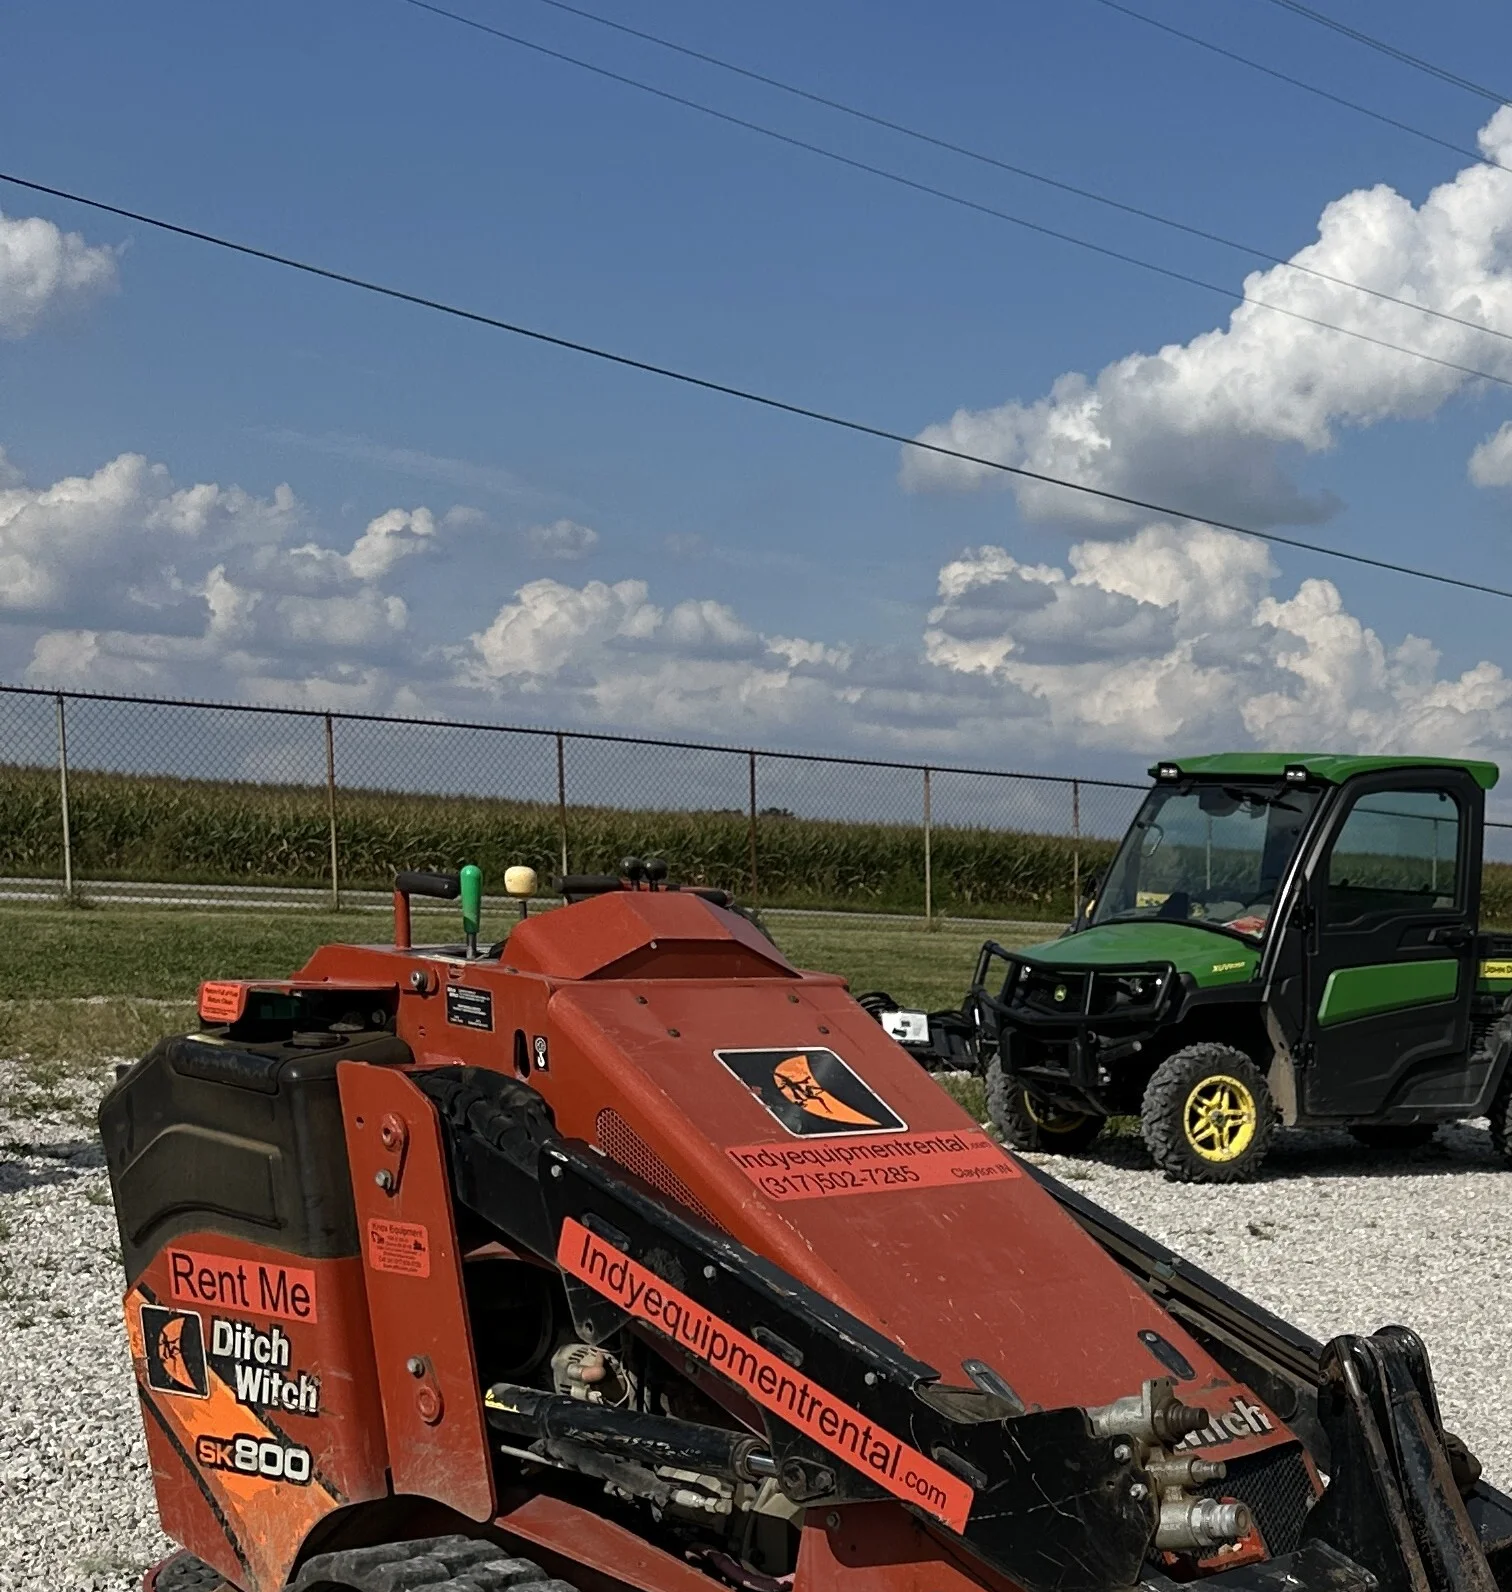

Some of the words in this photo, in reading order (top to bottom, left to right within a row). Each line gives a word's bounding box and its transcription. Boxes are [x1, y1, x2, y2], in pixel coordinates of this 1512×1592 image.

[1485, 965, 1506, 974] JOHN
[758, 1165, 920, 1198] (317)502-7285
[950, 1166, 998, 1179] Clayton
[171, 1252, 250, 1307] Rent
[258, 1266, 311, 1317] Me
[212, 1320, 289, 1366] Ditch
[235, 1364, 318, 1413] Witch
[579, 1234, 948, 1510] Indyequipmentrental.com
[199, 1438, 310, 1482] SK800
